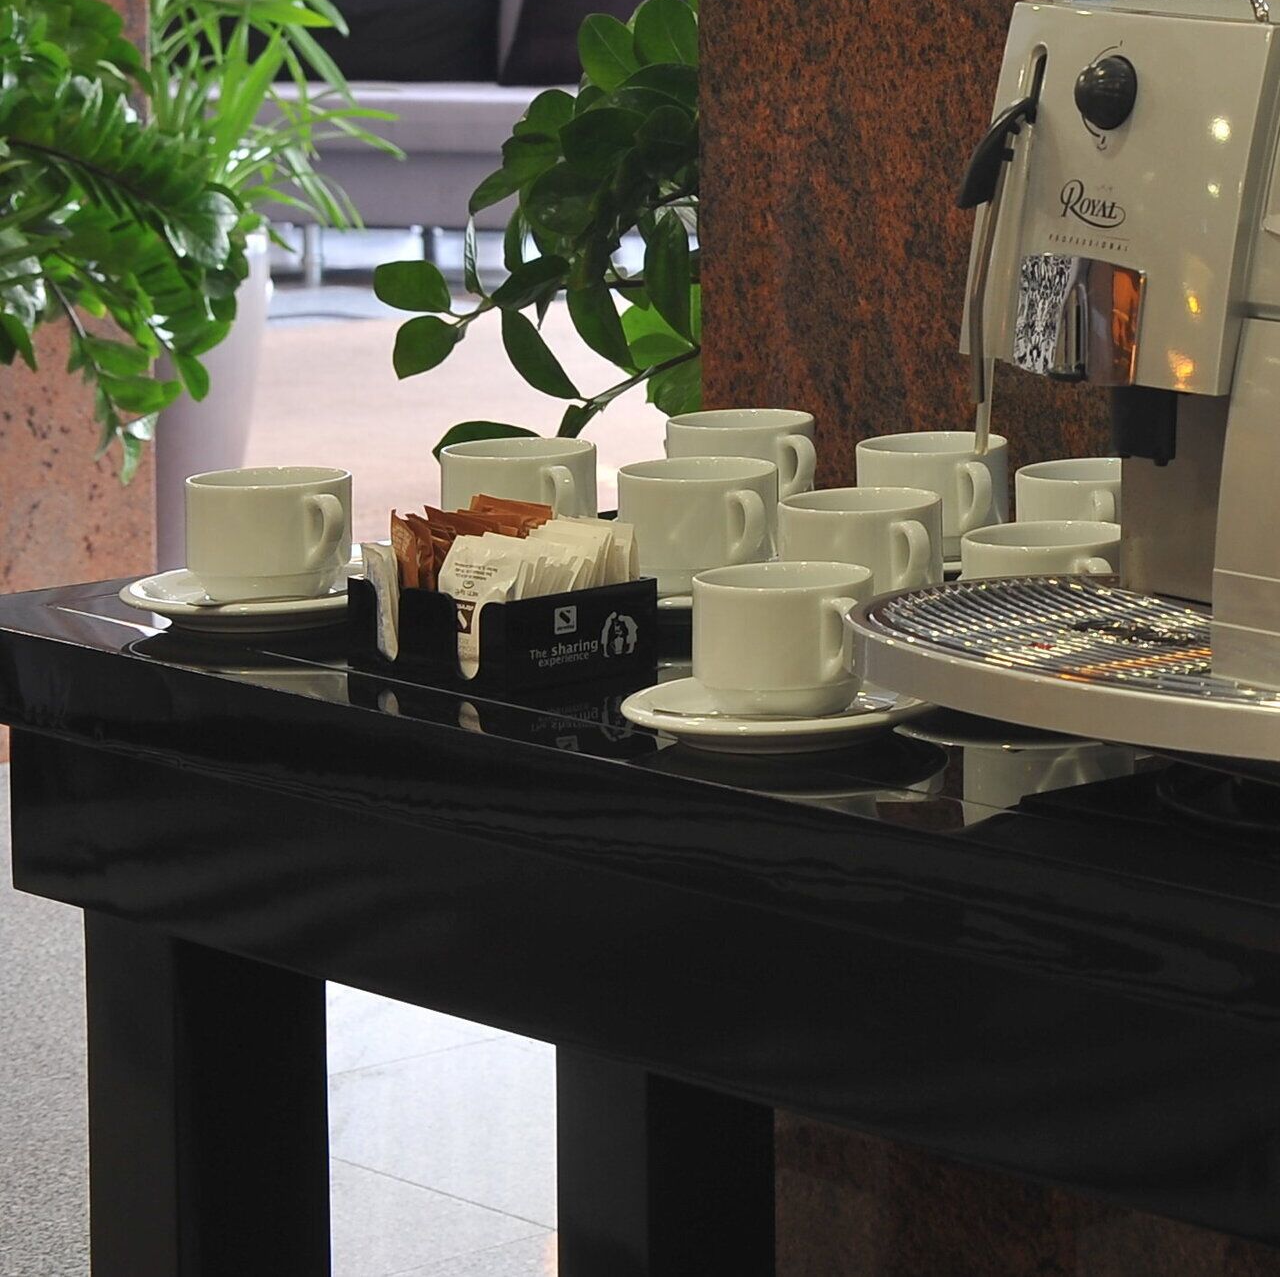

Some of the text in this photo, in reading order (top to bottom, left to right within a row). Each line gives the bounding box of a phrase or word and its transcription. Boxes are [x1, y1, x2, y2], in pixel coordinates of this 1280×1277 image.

[1060, 179, 1126, 228] ROYAL
[529, 639, 598, 660] The sharing
[538, 652, 590, 667] experience
